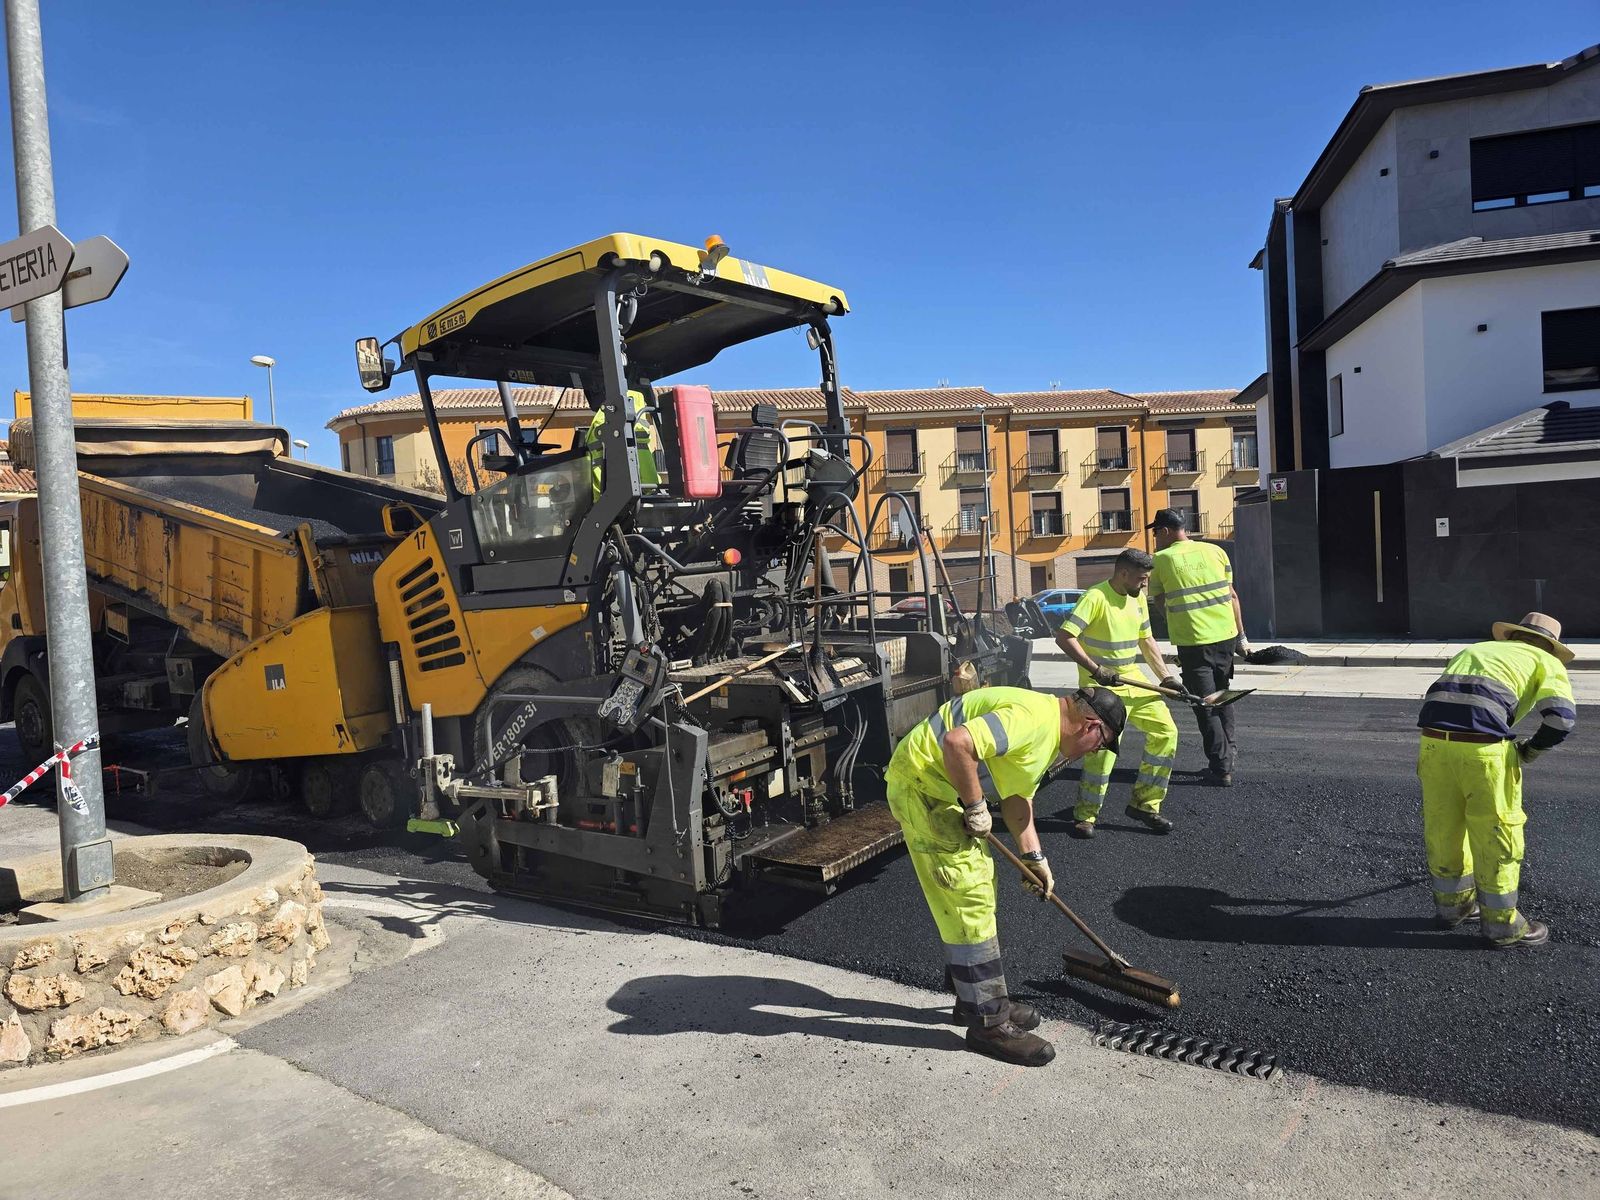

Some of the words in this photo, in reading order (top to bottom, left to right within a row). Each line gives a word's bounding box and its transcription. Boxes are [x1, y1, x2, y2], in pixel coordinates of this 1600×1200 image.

[414, 531, 426, 550] 17
[350, 551, 383, 564] NILA
[503, 701, 537, 745] 1803-3i
